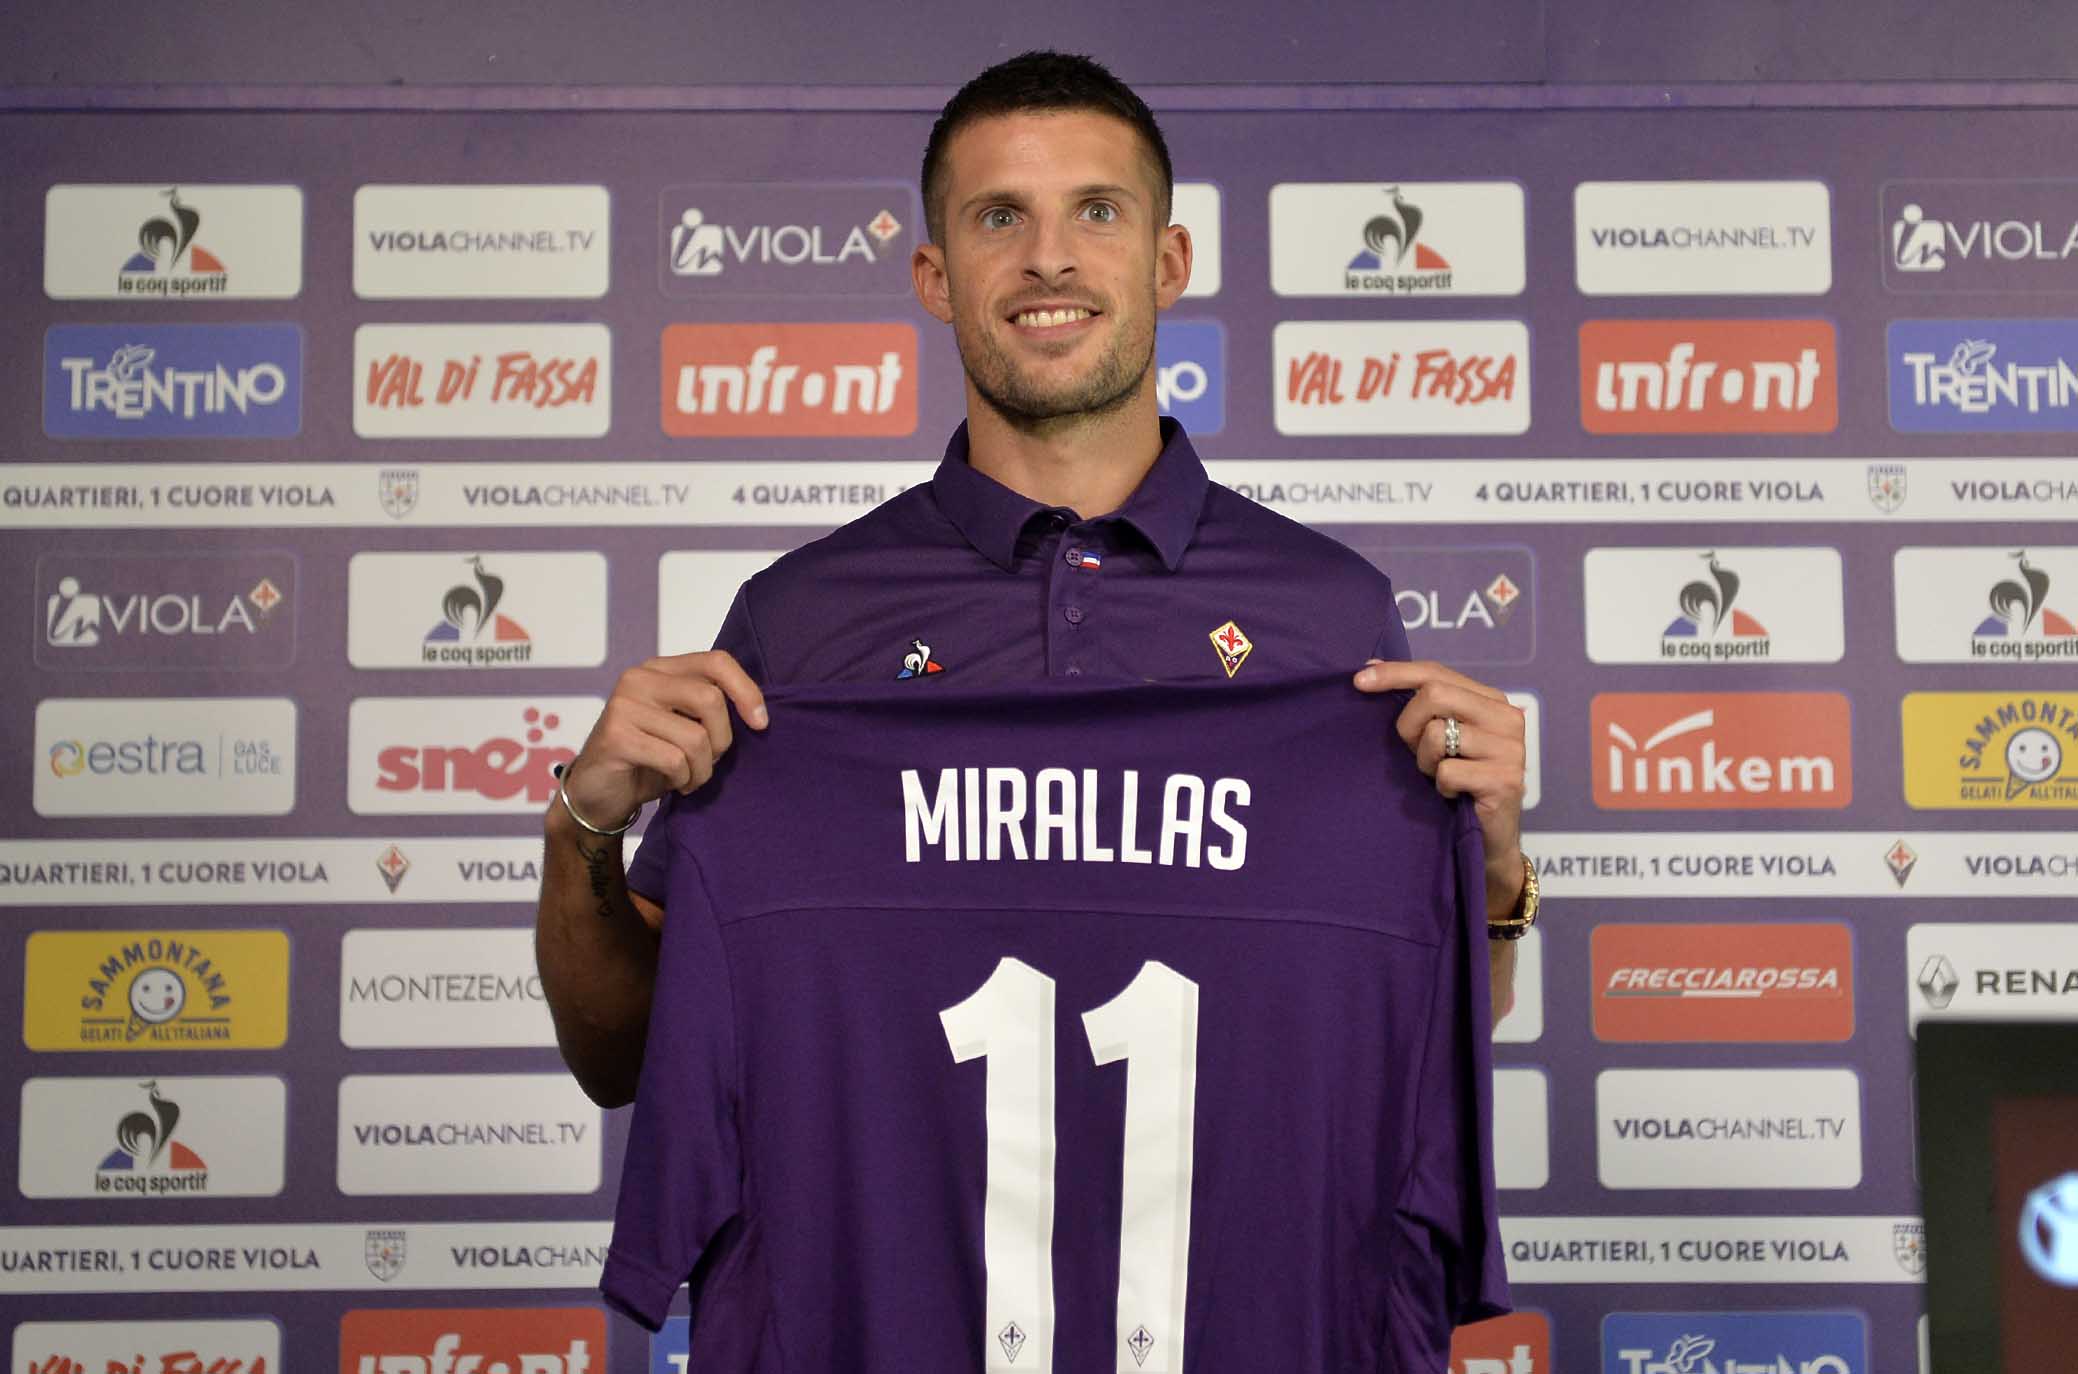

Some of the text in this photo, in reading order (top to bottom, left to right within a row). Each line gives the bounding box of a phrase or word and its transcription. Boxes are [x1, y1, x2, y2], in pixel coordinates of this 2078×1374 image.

[369, 231, 594, 253] VIOLACHANNEL.TV
[1591, 227, 1816, 249] VIOLACHANNEL.TV
[118, 274, 227, 297] le coq sportif
[1345, 271, 1452, 293] le coq sportif
[61, 358, 285, 420] TRENTINO
[366, 354, 423, 409] VAL
[490, 352, 598, 409] FASSA
[1287, 352, 1344, 406] VAL
[1411, 349, 1517, 406] FASSA
[150, 487, 160, 507] 1
[168, 486, 254, 509] CUORE
[260, 485, 335, 508] VIOLA
[462, 484, 690, 507] VIOLACHANNEL.TV
[732, 484, 886, 506] 4 QUARTIERI
[1234, 482, 1433, 504] OLACHANNEL.TV
[1476, 480, 1824, 505] 4 QUARTIERI, 1 CUORE VIOLA
[1395, 589, 1495, 630] OLA
[422, 644, 531, 666] le coq sportif
[1661, 638, 1770, 660] le coq sportif
[1971, 637, 1986, 656] le
[1990, 642, 2021, 660] coq
[87, 735, 206, 776] estra
[1609, 710, 1834, 793] linkem
[233, 757, 281, 775] LUCE
[901, 767, 1251, 871] MIRALLAS
[141, 864, 151, 883] 1
[158, 862, 245, 884] CUORE
[252, 861, 328, 883] VIOLA
[1650, 857, 1660, 876] 1
[1667, 856, 1754, 877] CUORE
[1760, 856, 1837, 877] VIOLA
[81, 939, 231, 1011] SAMMONTANA
[1607, 967, 1839, 990] FRECCIAROSSA
[355, 1124, 587, 1146] VIOLACHANNEL.TV
[1614, 1118, 1845, 1140] VIOLACHANNEL.TV
[939, 957, 1199, 1374] 11
[95, 1172, 208, 1195] le coq sportif
[1, 1248, 320, 1273] UARTIERI, 1 CUORE VIOLA
[1511, 1240, 1850, 1265] QUARTIERI, 1 CUORE VIOLA
